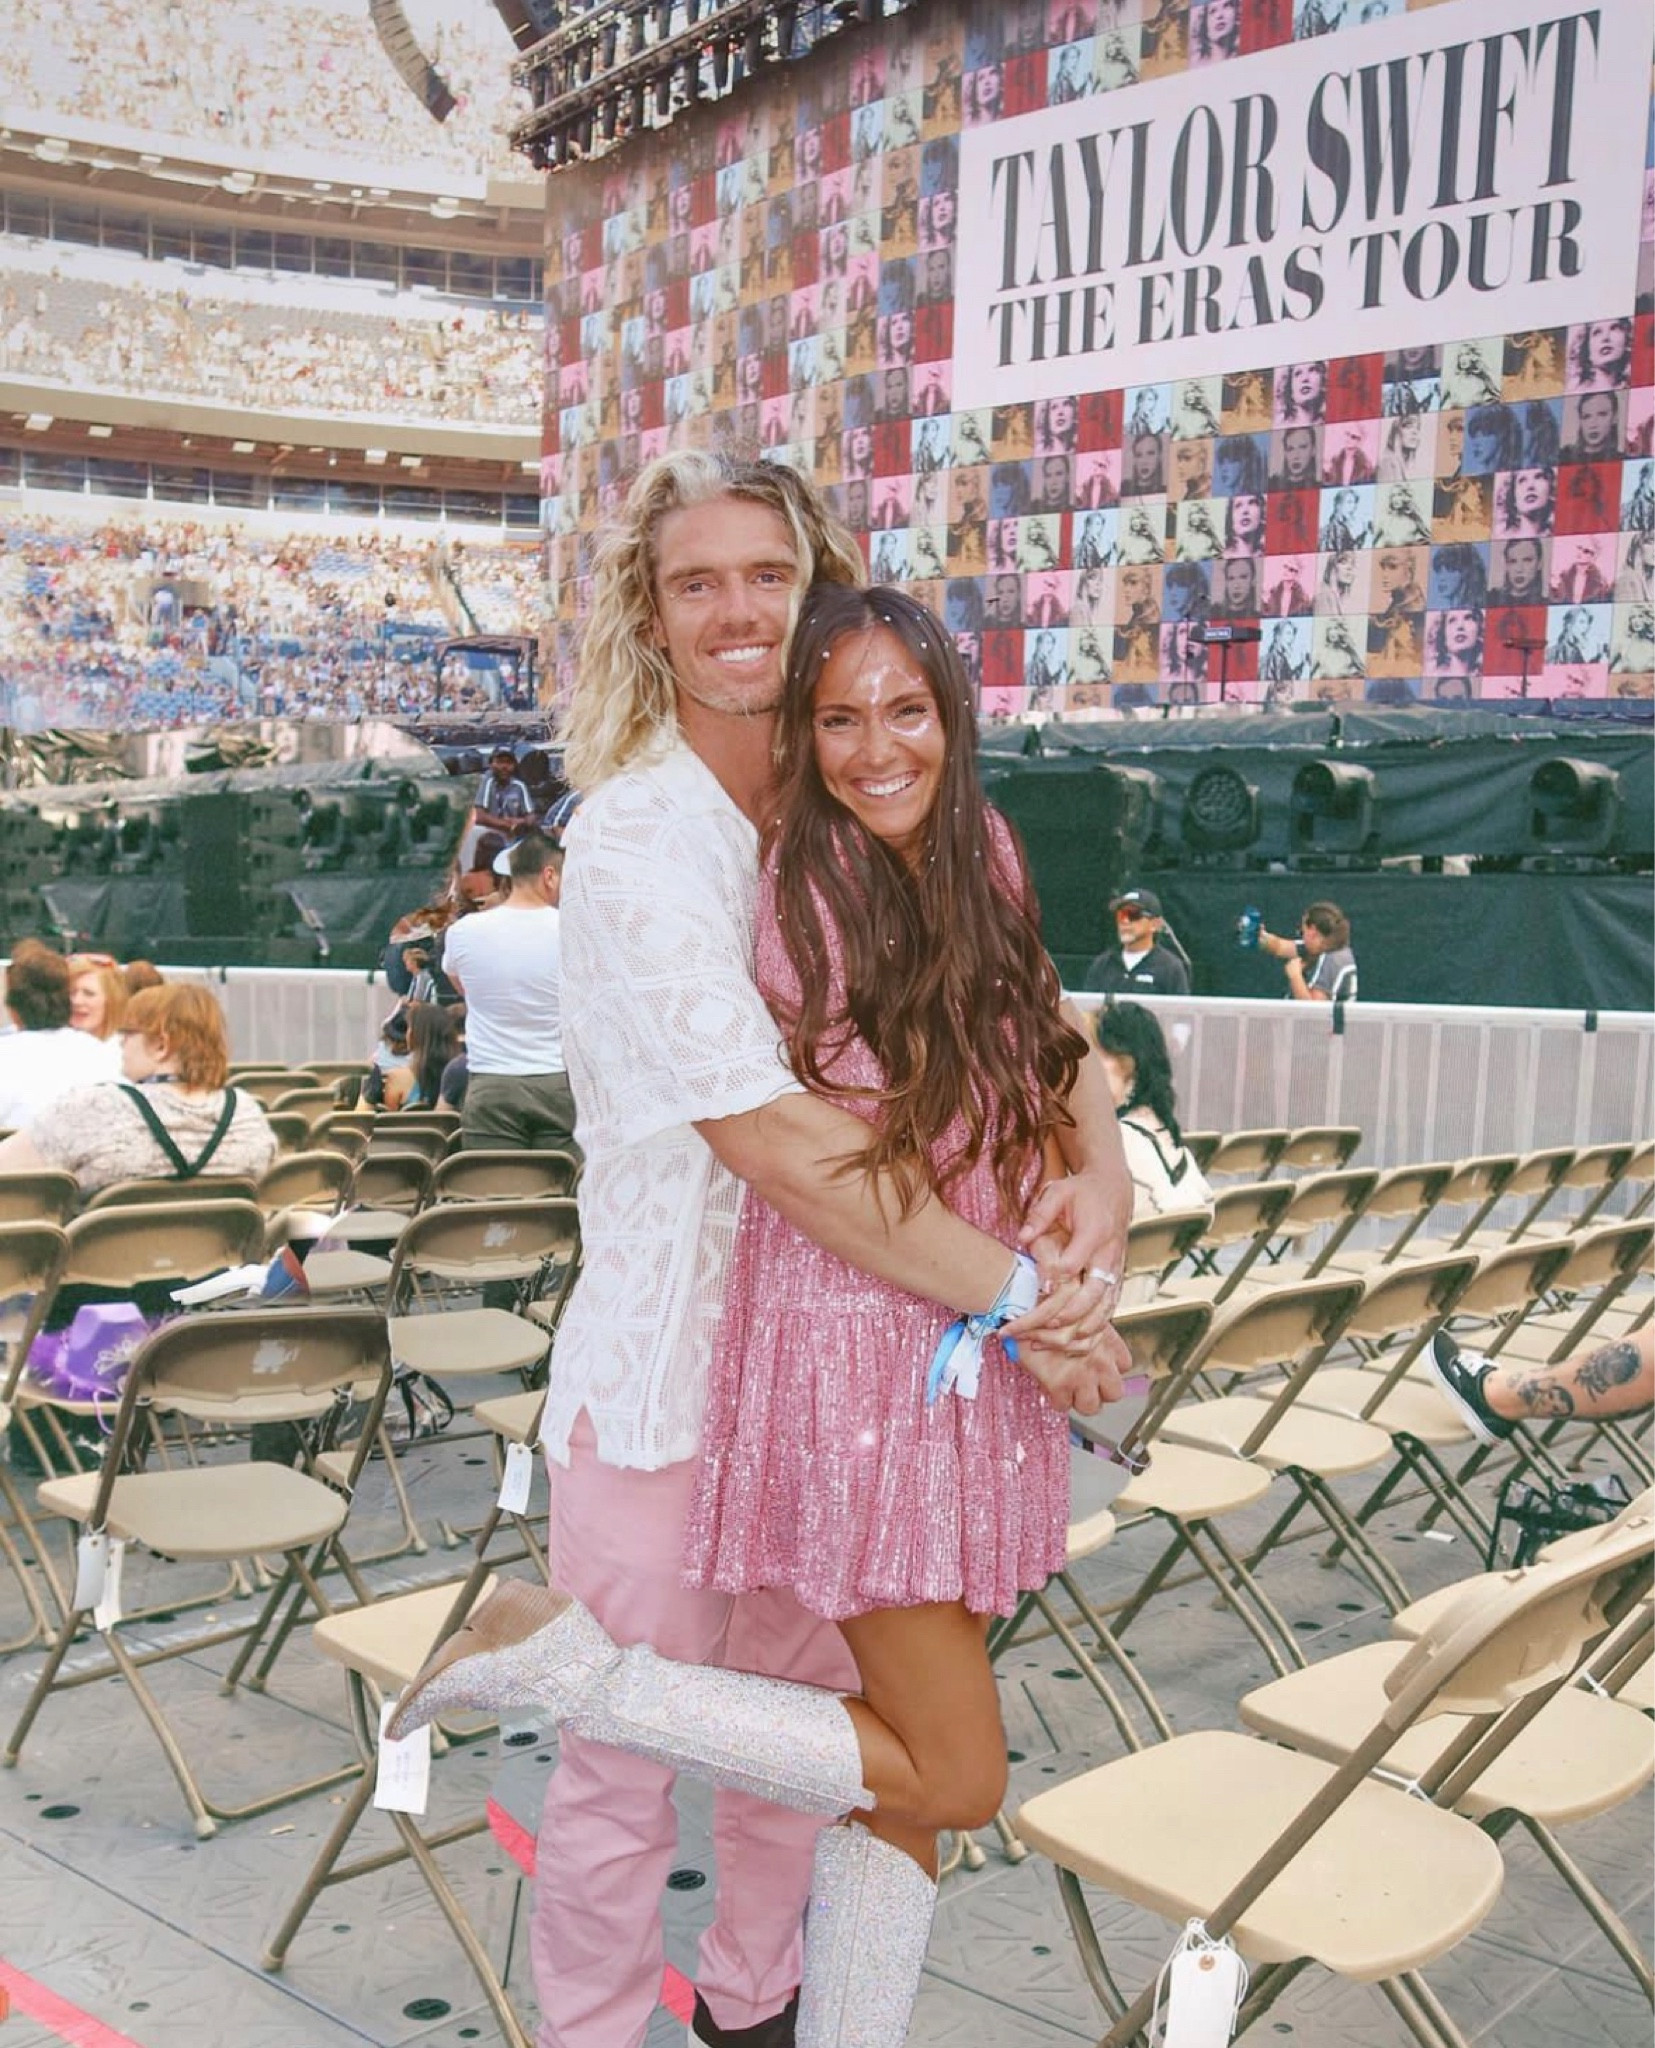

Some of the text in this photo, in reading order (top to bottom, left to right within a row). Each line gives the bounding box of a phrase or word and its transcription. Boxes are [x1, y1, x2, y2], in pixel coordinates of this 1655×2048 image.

[991, 9, 1600, 291] TAYLOR SWIFT
[988, 199, 1584, 366] THE ERAS TOUR
